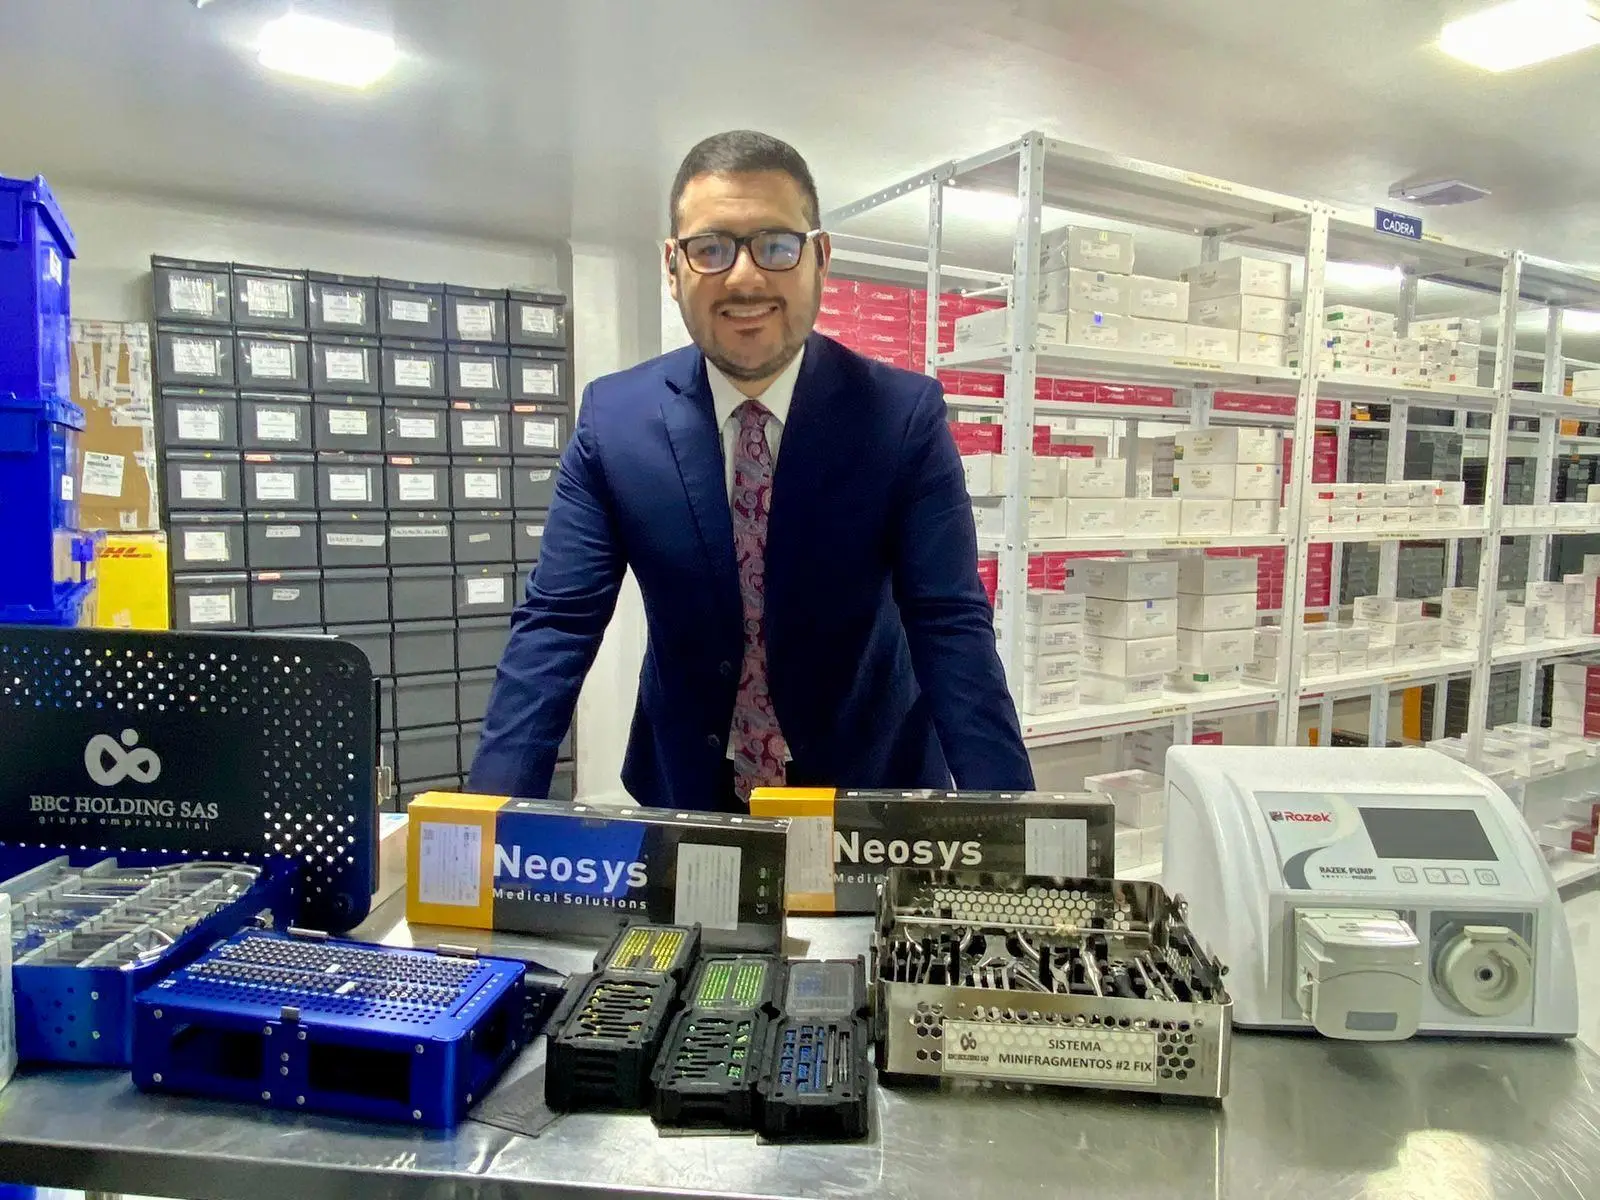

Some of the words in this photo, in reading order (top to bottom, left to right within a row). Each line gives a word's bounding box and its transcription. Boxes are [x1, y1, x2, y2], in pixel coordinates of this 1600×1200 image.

[1382, 218, 1415, 236] CADERA
[29, 795, 70, 812] BBC
[74, 797, 176, 817] HOLDING
[180, 801, 219, 820] SAS
[1284, 811, 1331, 822] Razek
[38, 816, 88, 825] grupo
[100, 818, 210, 831] empresarial
[834, 831, 982, 870] Neosys
[494, 843, 648, 893] Neosys
[1319, 866, 1348, 874] RAZEK
[1349, 867, 1373, 875] PUMP
[493, 888, 558, 903] Medical
[563, 893, 647, 910] Solutions
[1049, 1039, 1101, 1051] SISTEMA
[999, 1054, 1112, 1069] MINIFRAGMENTOS
[1115, 1061, 1130, 1071] #2
[1134, 1061, 1153, 1072] FIX
